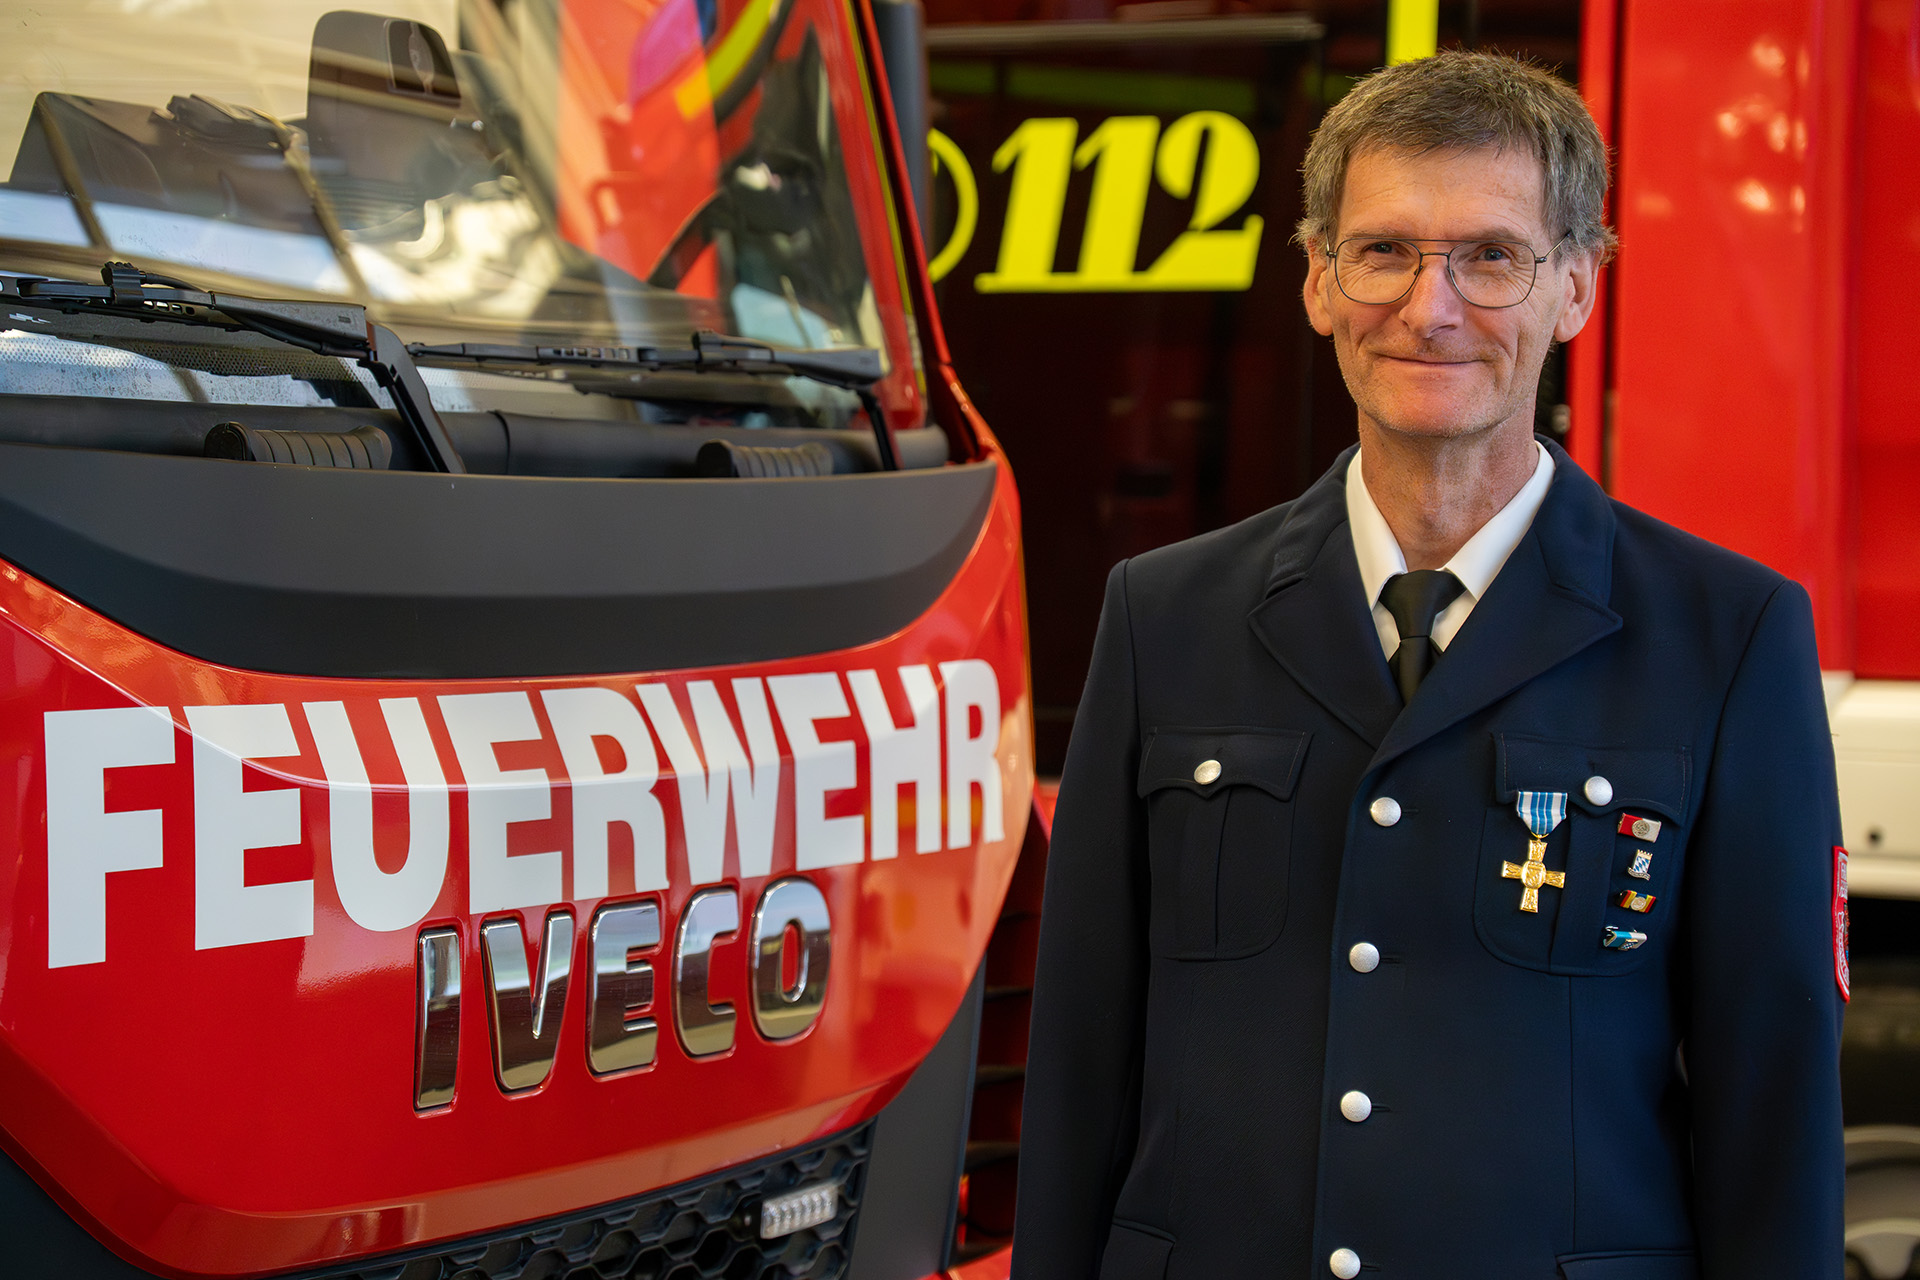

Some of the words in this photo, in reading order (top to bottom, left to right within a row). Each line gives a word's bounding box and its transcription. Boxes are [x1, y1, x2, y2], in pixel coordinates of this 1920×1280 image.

[974, 110, 1264, 293] 112
[44, 659, 1005, 969] FEUERWEHR
[413, 878, 832, 1115] IVECO
